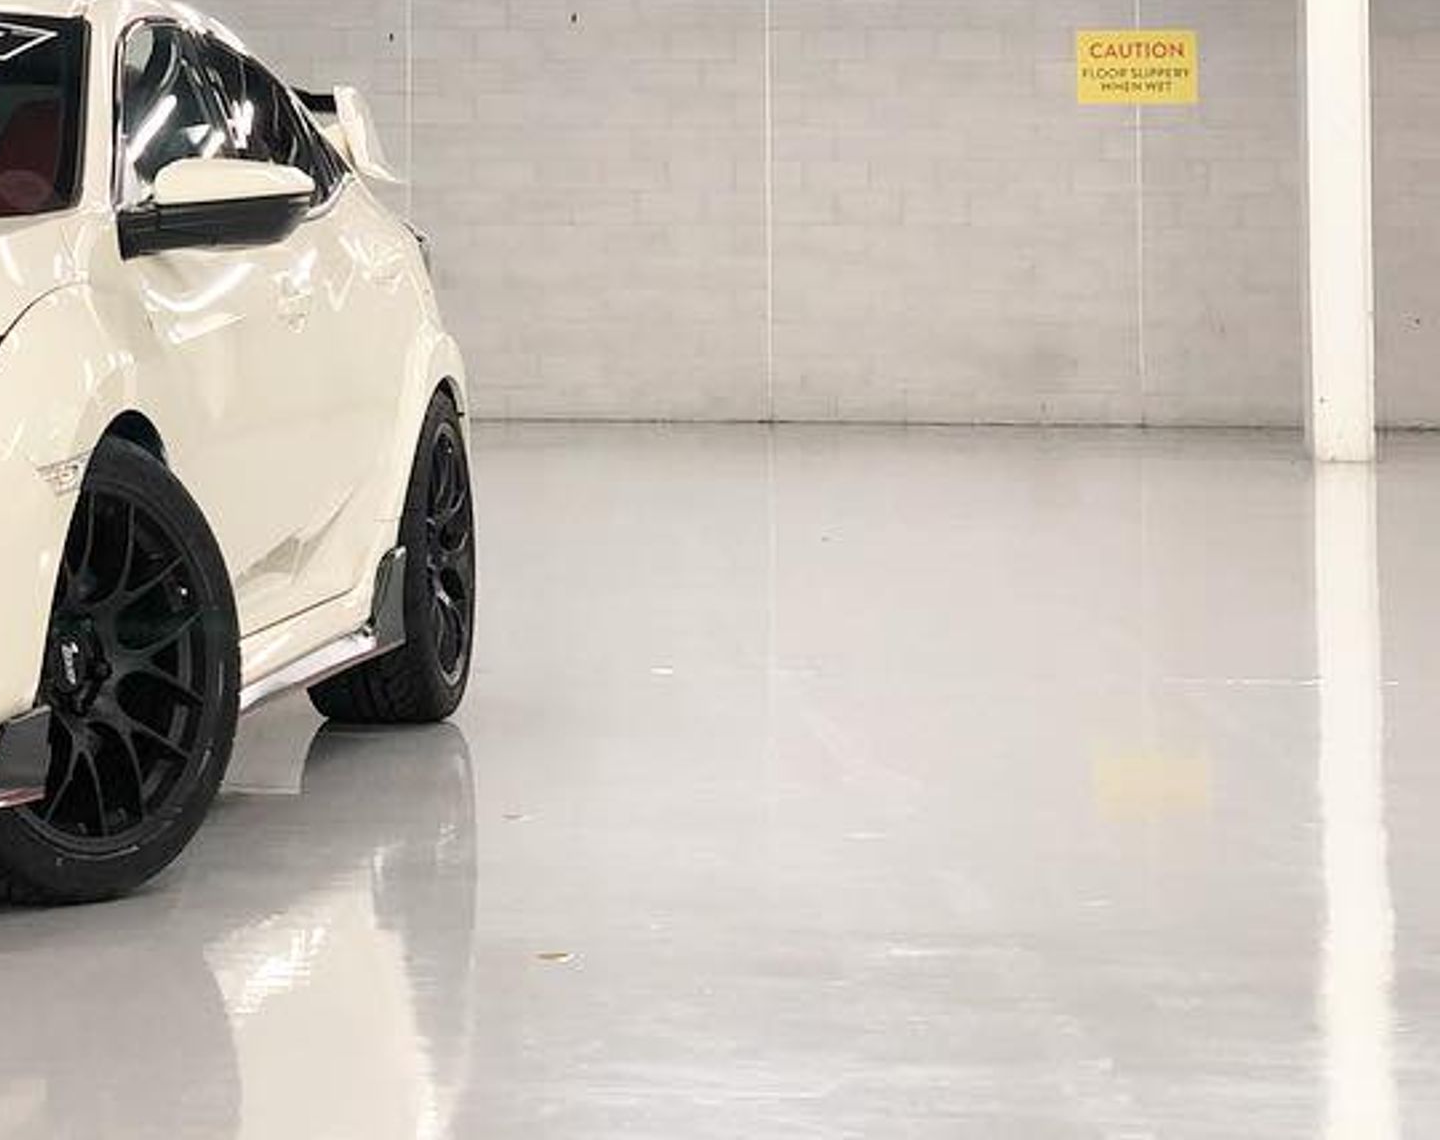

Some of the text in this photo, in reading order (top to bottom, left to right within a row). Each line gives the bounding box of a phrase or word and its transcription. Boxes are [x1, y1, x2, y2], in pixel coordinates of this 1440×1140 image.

[1089, 42, 1185, 59] CAUTION
[1081, 66, 1189, 79] FLOOR SLIPPERY
[1100, 81, 1173, 93] WHEN WET
